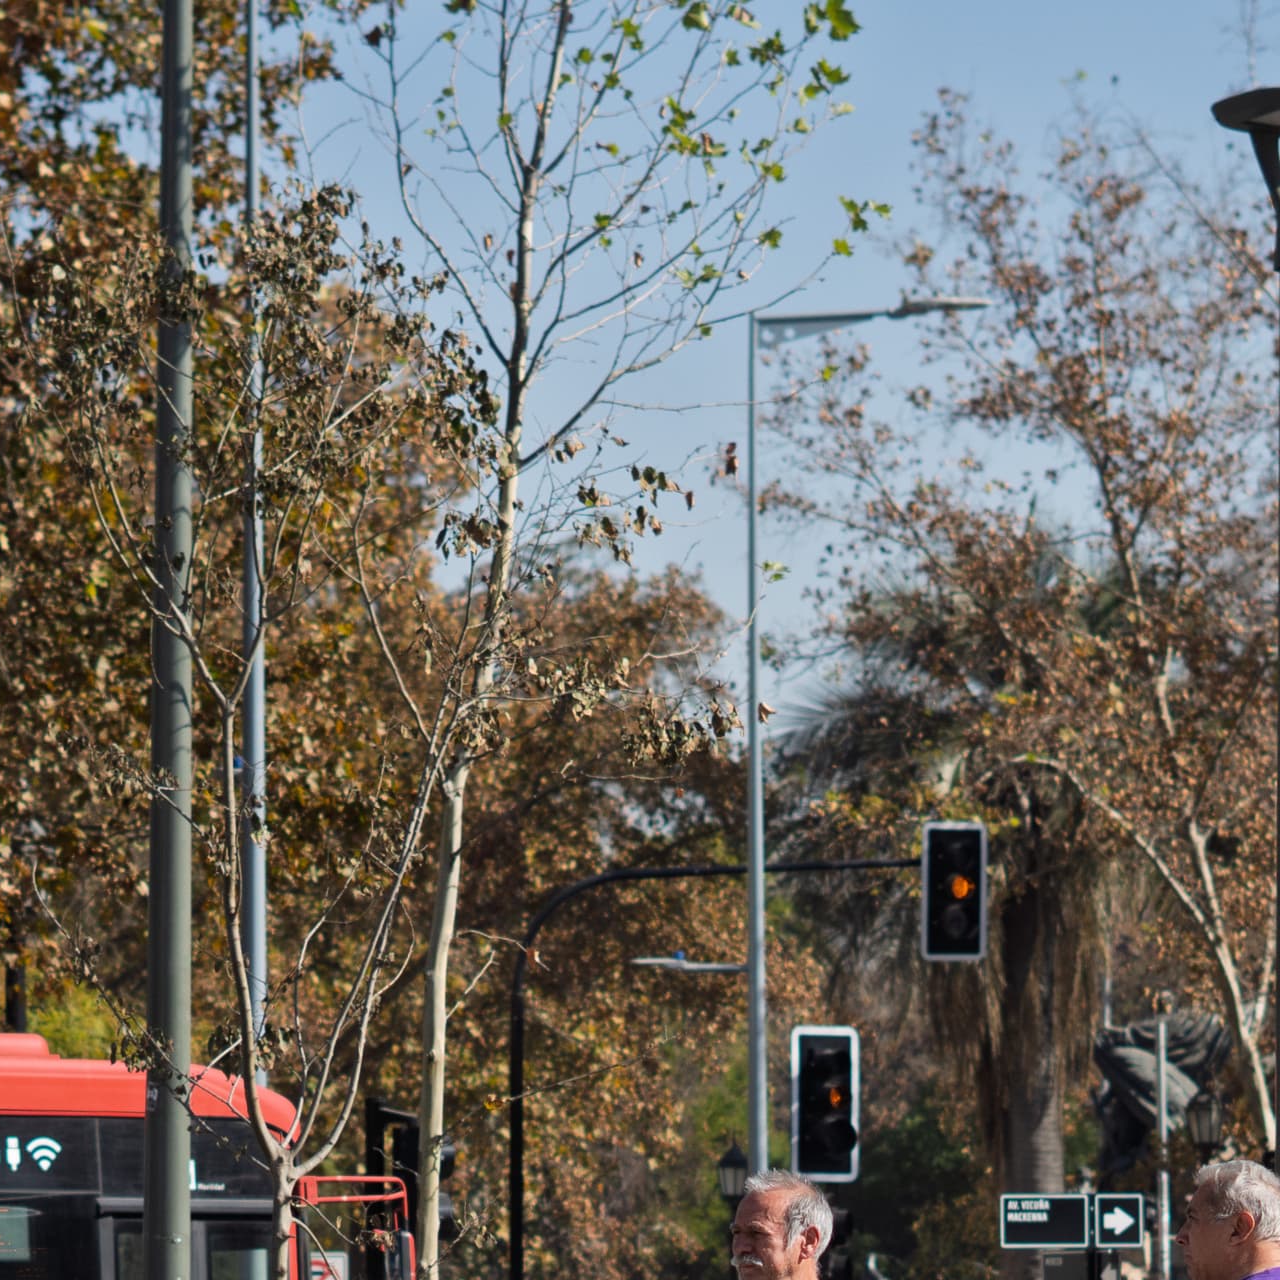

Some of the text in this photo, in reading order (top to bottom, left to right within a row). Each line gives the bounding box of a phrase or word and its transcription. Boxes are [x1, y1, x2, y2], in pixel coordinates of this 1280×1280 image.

[1007, 1198, 1050, 1210] AV. VICUÑA
[1007, 1212, 1048, 1222] MACKENNA
